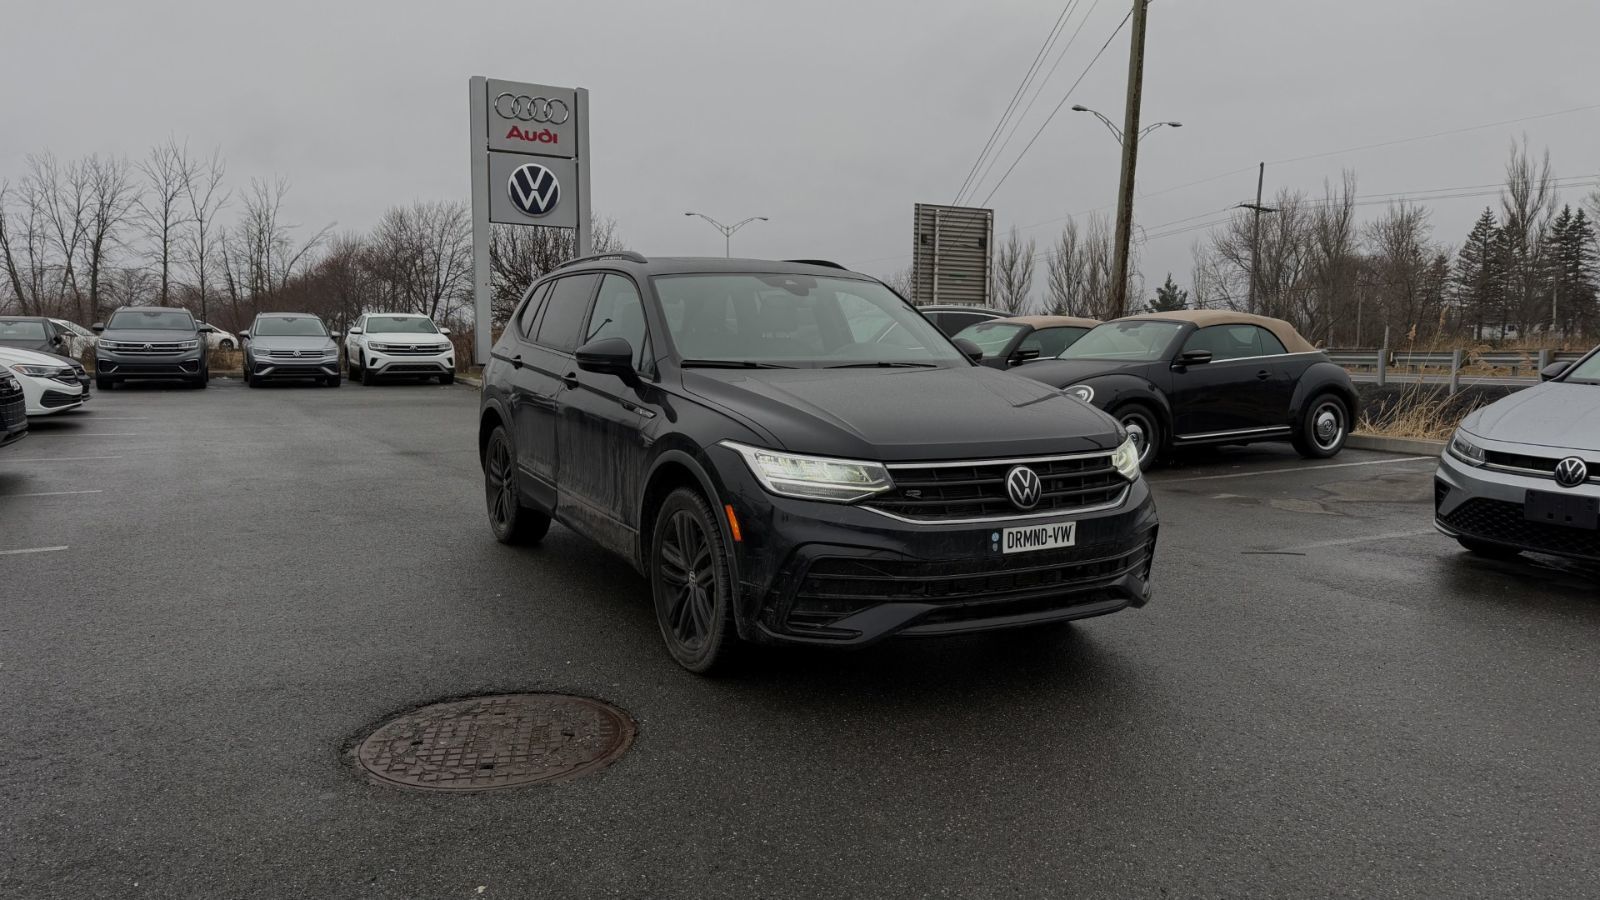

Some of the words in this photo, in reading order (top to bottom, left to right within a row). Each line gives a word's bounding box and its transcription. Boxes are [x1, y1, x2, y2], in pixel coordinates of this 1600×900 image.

[506, 126, 557, 144] Audi
[510, 165, 558, 213] VW
[1009, 467, 1040, 506] VW
[1007, 525, 1072, 549] DRMND-VW
